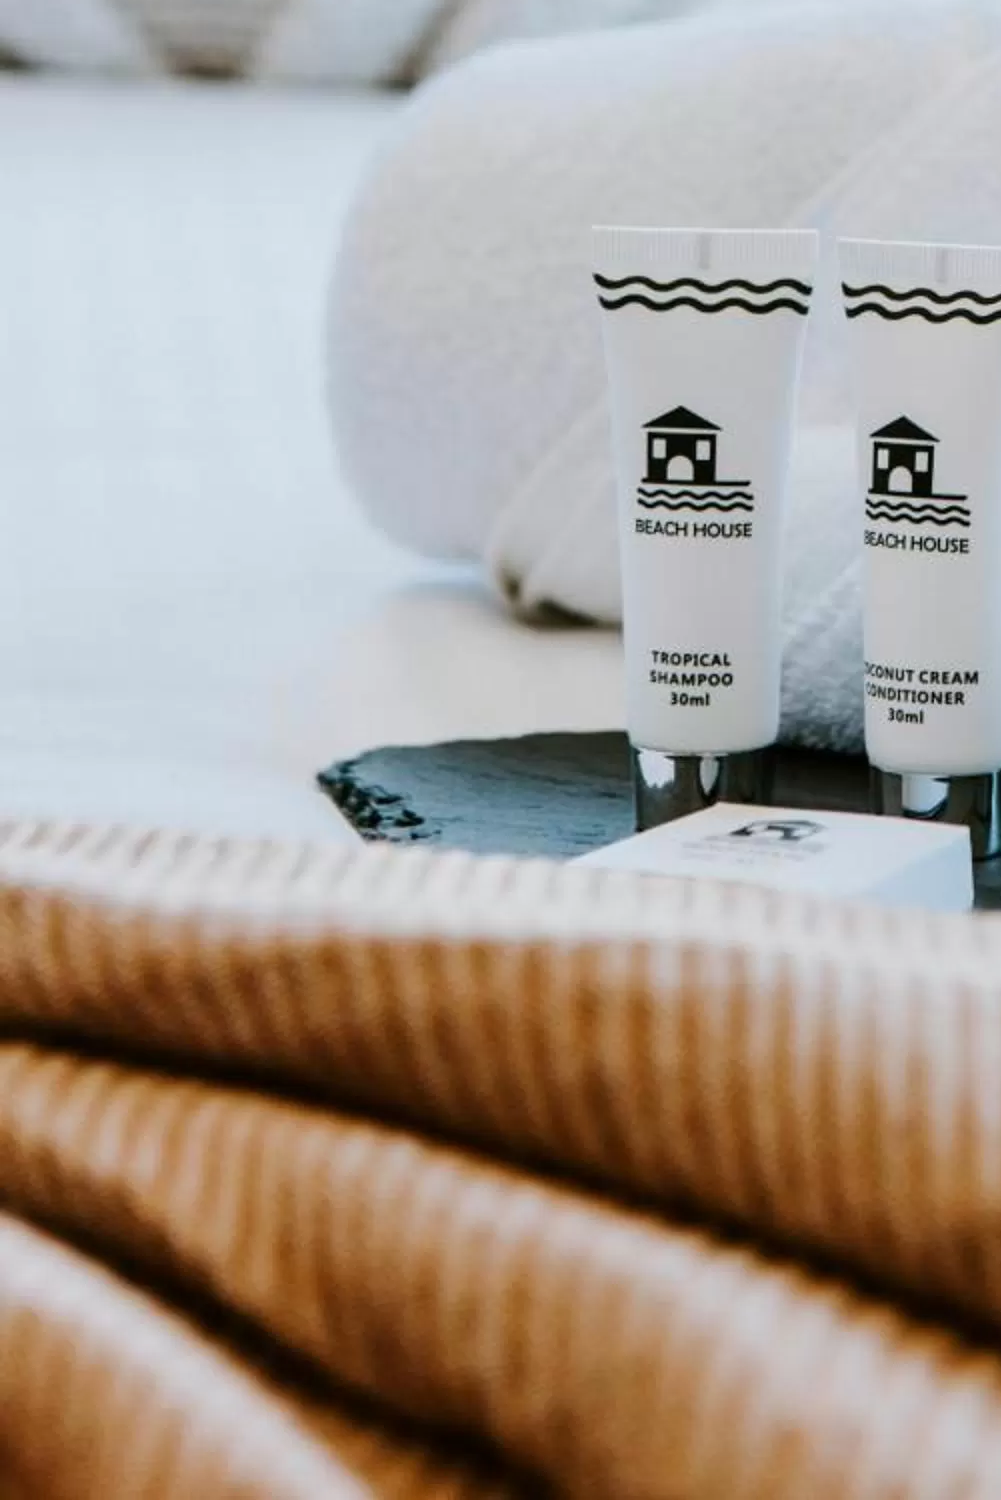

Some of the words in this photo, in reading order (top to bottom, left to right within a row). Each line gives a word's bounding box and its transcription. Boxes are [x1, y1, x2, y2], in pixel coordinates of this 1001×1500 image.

[635, 519, 687, 537] BEACH
[694, 522, 752, 538] HOUSE
[911, 535, 969, 554] HOUSE
[652, 651, 731, 667] TROPICAL
[649, 670, 733, 687] SHAMPOO
[919, 670, 979, 685] CREAM
[671, 692, 710, 706] 30ml
[888, 707, 924, 724] 30ml
